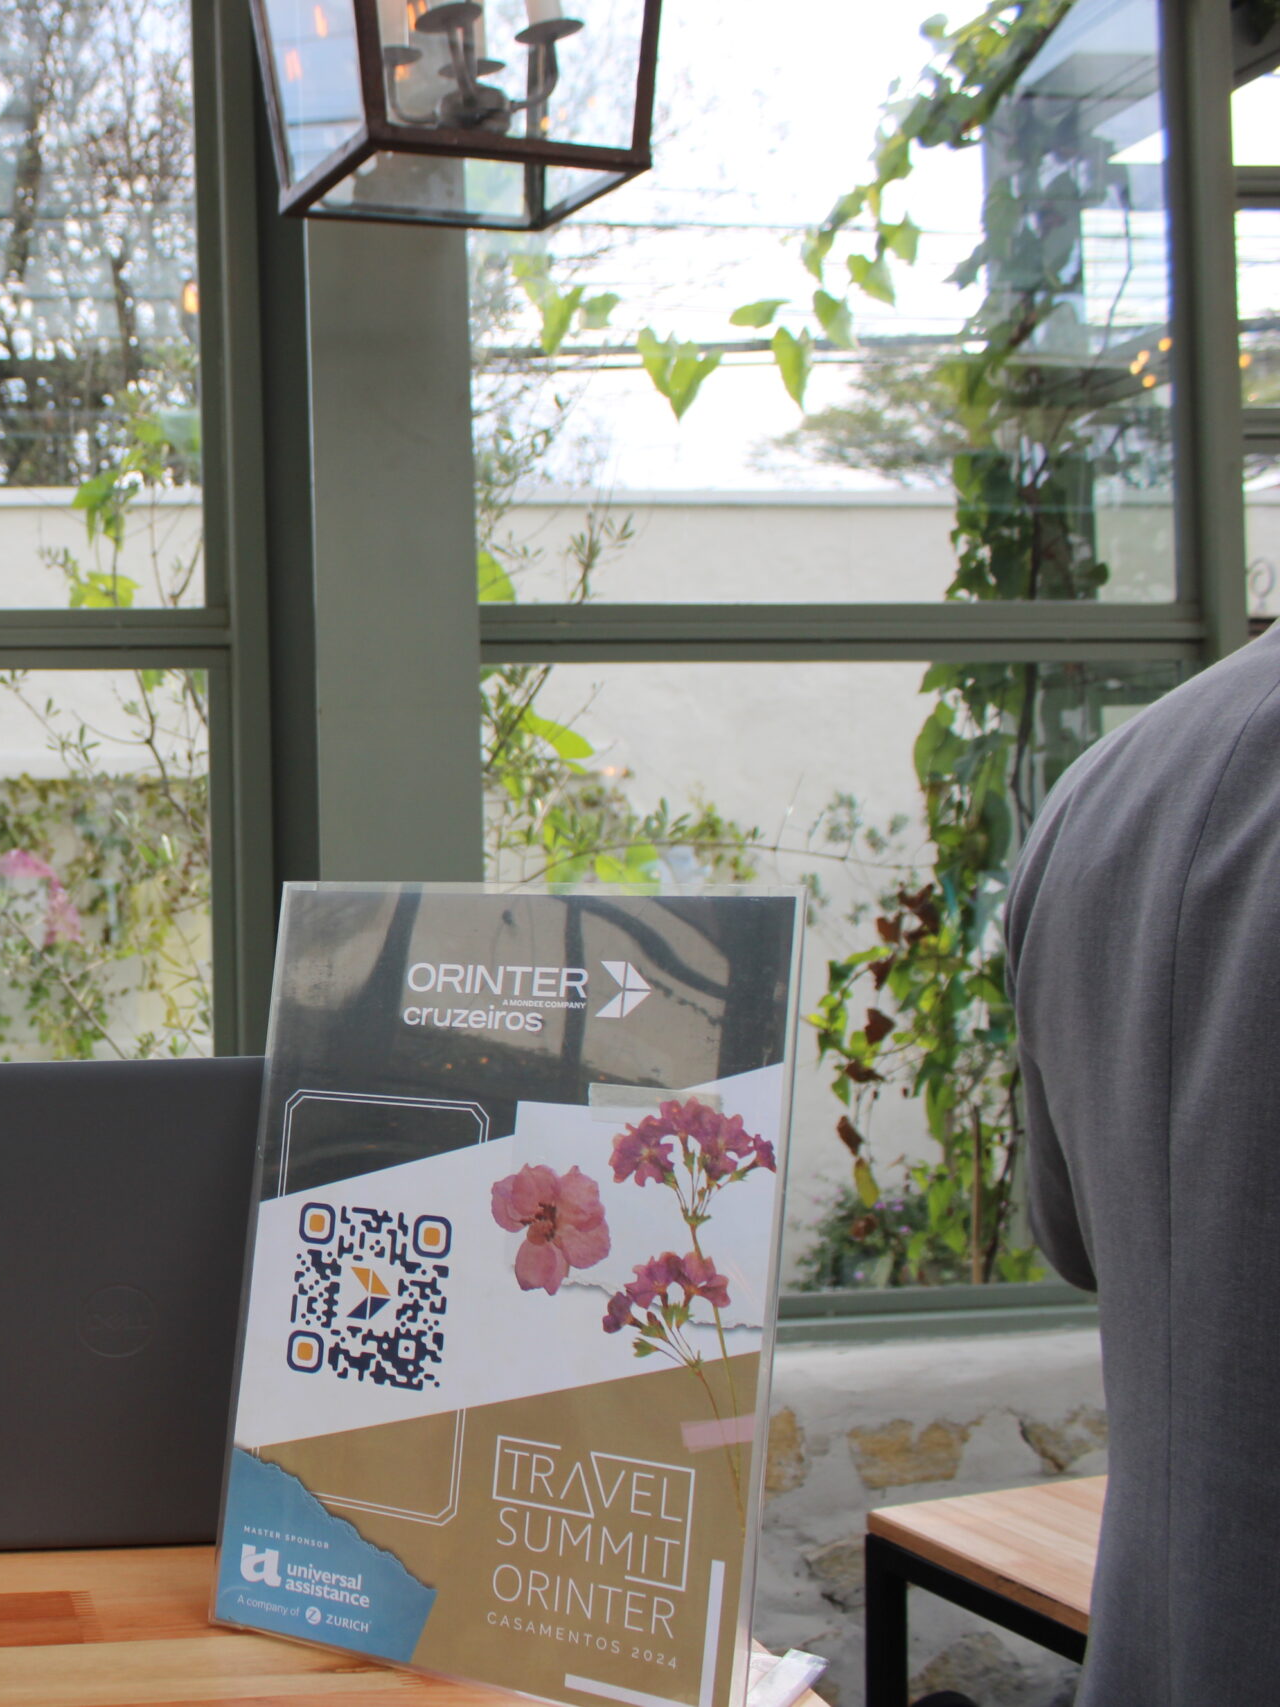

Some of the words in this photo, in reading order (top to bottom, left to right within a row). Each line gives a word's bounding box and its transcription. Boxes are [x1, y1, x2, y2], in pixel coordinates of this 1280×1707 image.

[407, 962, 589, 998] ORINTER
[403, 1005, 544, 1032] cruzeiros
[544, 1001, 586, 1009] COMPANY
[504, 1448, 682, 1522] TRAVEL
[243, 1525, 281, 1540] MASTER
[285, 1534, 330, 1549] SPONSOR
[496, 1506, 681, 1578] SUMMIT
[286, 1563, 362, 1590] universal
[237, 1594, 245, 1605] A
[246, 1598, 288, 1616] company
[290, 1607, 300, 1617] of
[285, 1578, 370, 1608] assistance
[492, 1563, 676, 1639] ORINTER
[487, 1611, 621, 1654] CASAMENTOS
[631, 1647, 678, 1670] 2024
